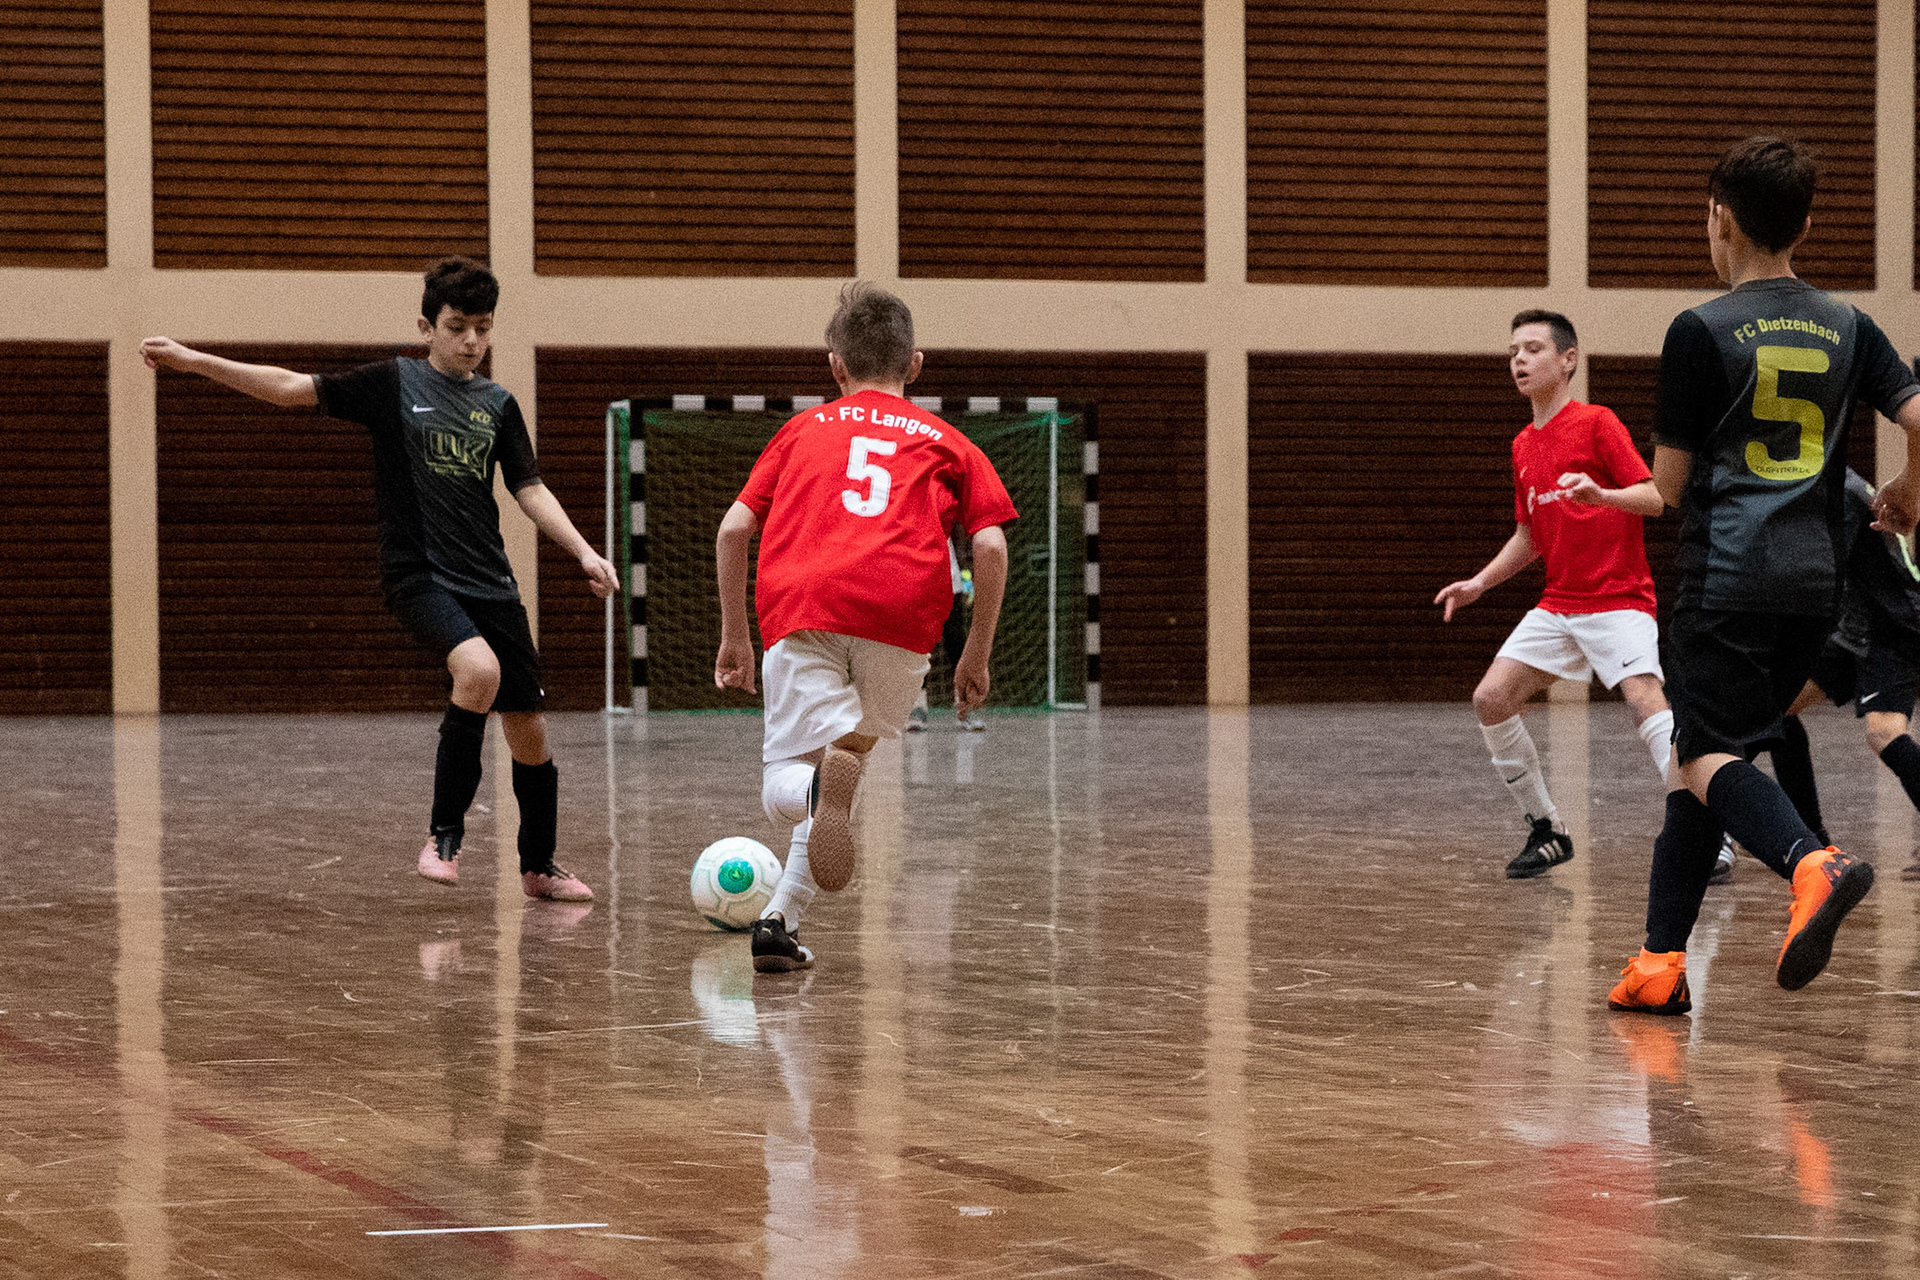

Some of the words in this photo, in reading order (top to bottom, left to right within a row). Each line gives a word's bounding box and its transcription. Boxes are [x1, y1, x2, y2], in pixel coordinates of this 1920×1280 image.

[1733, 323, 1756, 344] FC
[1756, 316, 1841, 345] Dietzenbach
[814, 412, 834, 423] 1.
[838, 406, 866, 421] FC
[870, 408, 943, 441] Langen
[1744, 345, 1830, 481] 5
[841, 435, 898, 517] 5
